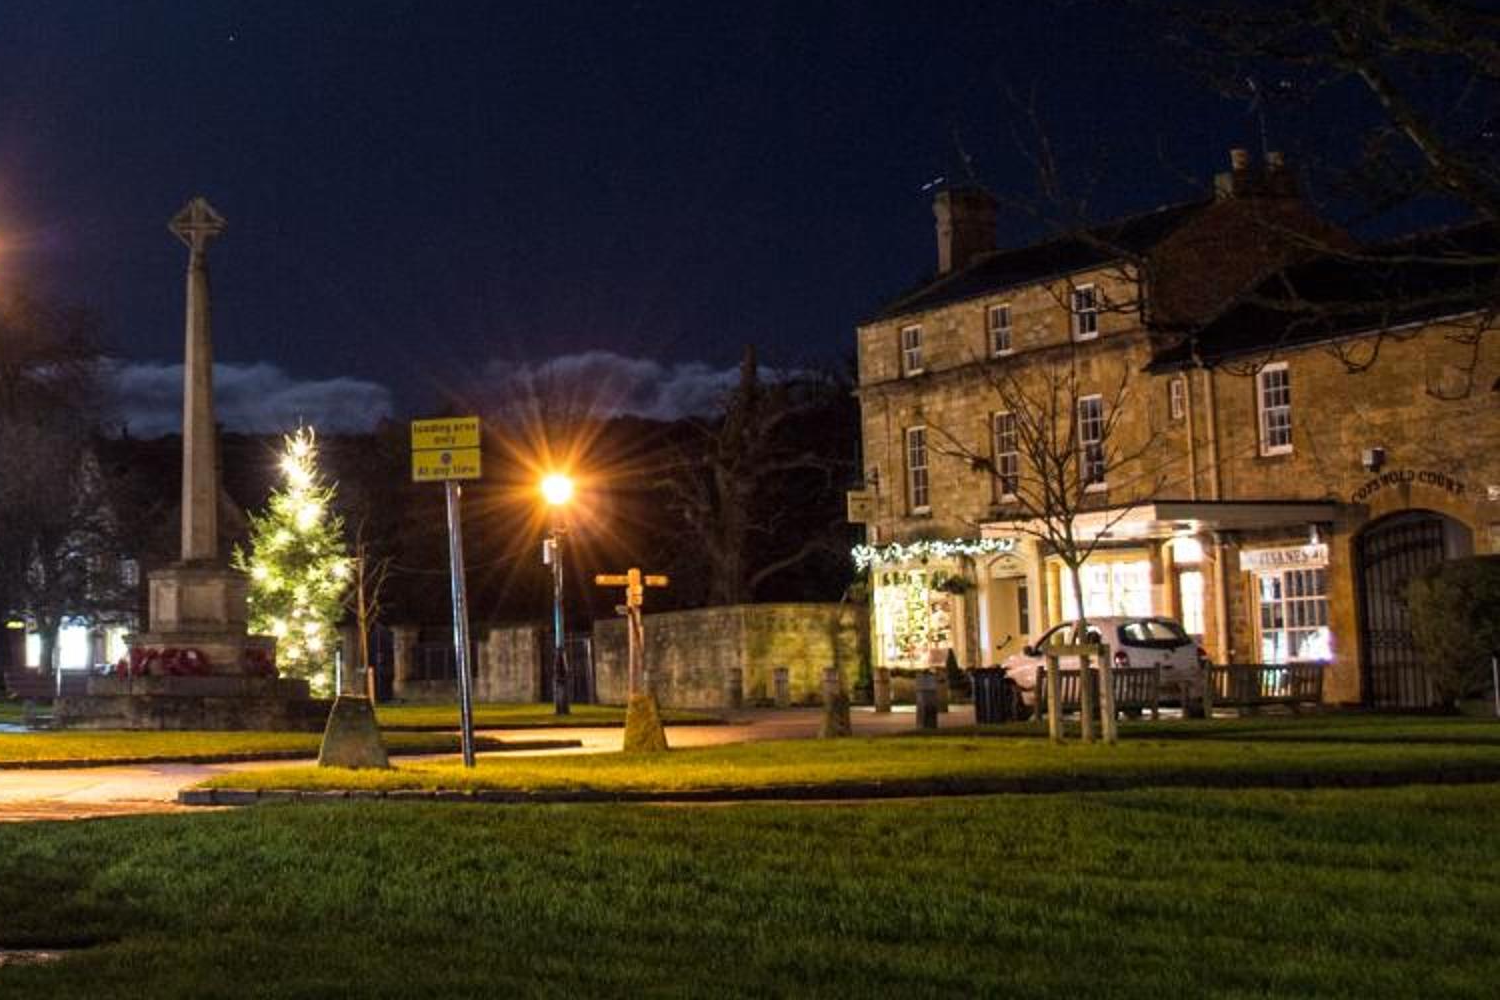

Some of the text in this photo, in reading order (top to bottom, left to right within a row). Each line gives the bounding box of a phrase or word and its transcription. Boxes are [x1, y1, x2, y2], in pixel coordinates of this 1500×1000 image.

[454, 422, 477, 432] area
[418, 464, 429, 475] At
[1351, 470, 1464, 504] COTSWOLD COURT
